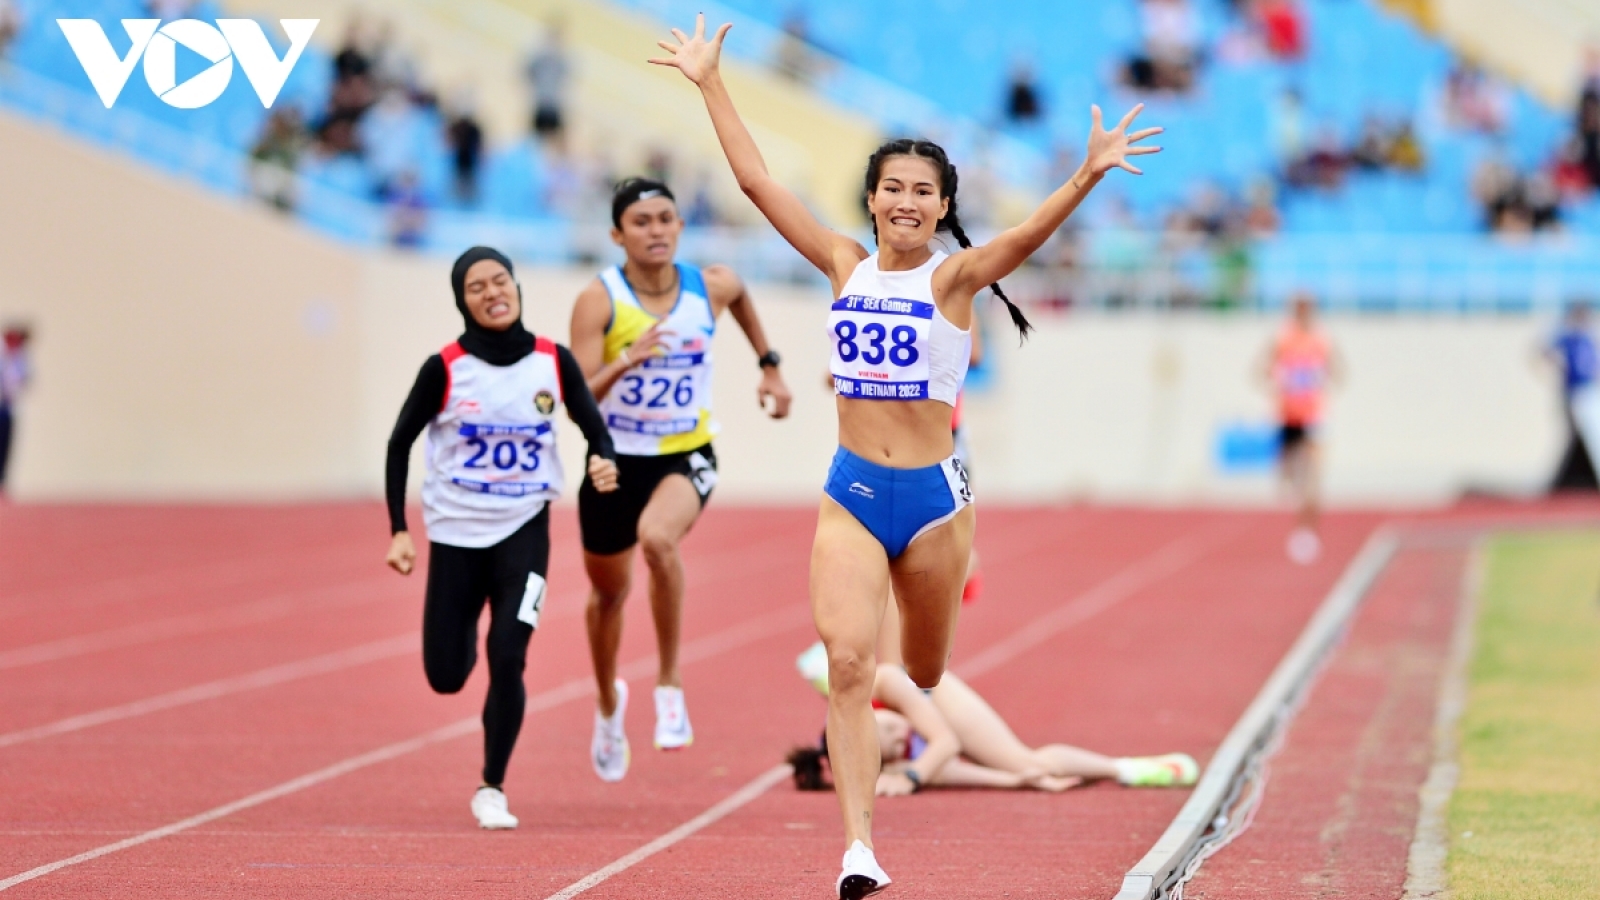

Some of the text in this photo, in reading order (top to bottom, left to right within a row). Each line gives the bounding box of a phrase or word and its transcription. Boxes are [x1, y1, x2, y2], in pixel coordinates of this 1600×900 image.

[863, 296, 880, 311] SEA
[881, 298, 913, 313] Games
[834, 320, 919, 367] 838
[858, 370, 889, 379] VIETNAM
[620, 374, 693, 408] 326
[860, 382, 897, 397] VIETNAM
[898, 383, 921, 398] 2022
[463, 437, 543, 471] 203
